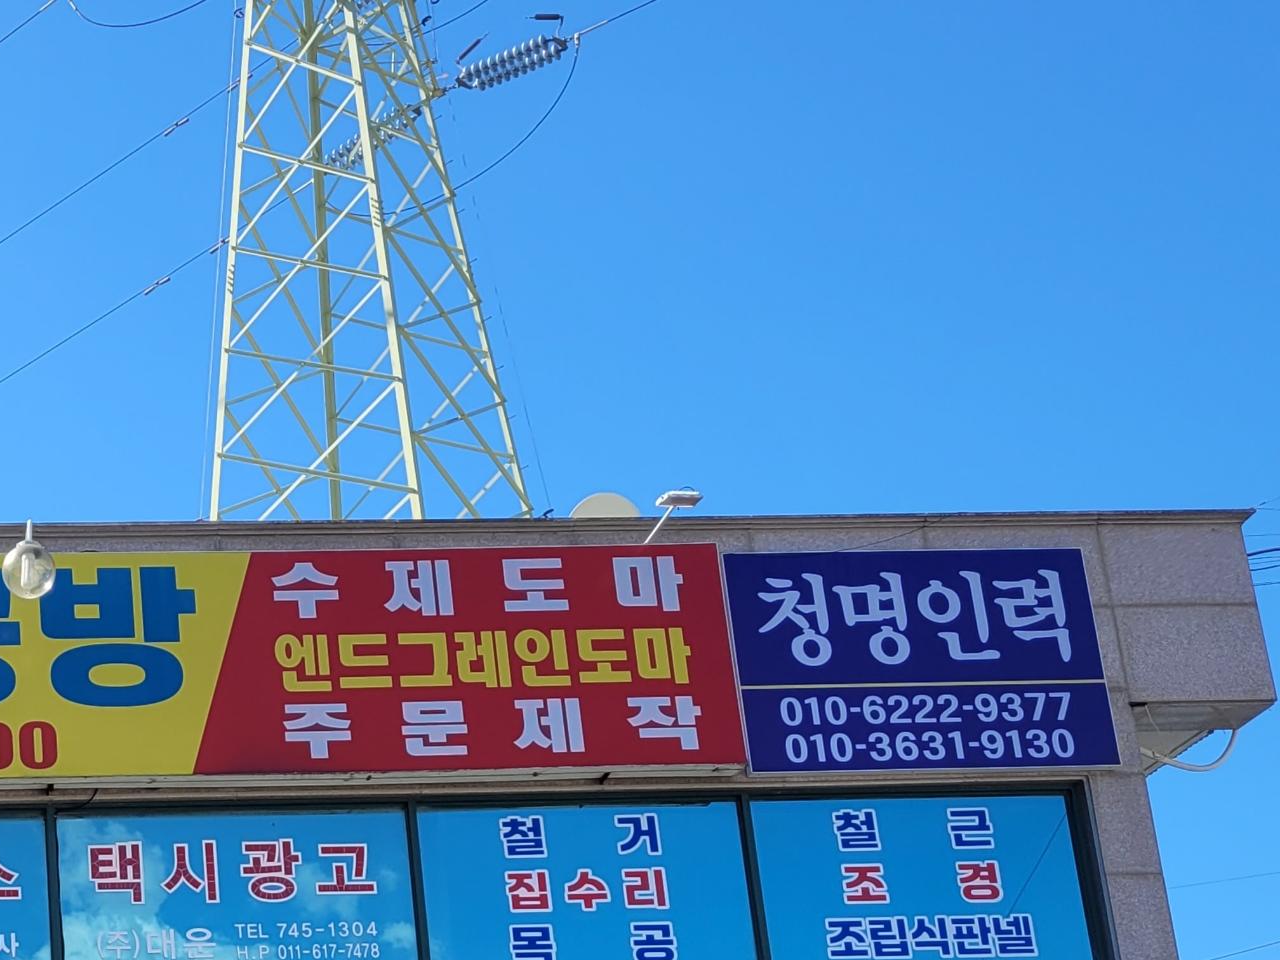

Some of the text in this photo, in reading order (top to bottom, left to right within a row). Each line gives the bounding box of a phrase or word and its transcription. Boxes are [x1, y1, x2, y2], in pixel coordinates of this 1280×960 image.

[756, 569, 1072, 667] 청명인력
[274, 627, 692, 692] 엔드그레인도마
[779, 692, 1072, 727] 010-6222-9377
[785, 728, 1075, 763] 010-3631-9130
[86, 838, 378, 904] 택시광고
[504, 866, 670, 914] 집수리
[95, 926, 217, 960] (주)대운
[234, 920, 379, 940] TEL 745-1304
[825, 911, 1040, 960] 조립식판넬
[277, 942, 381, 960] 011-617-7478
